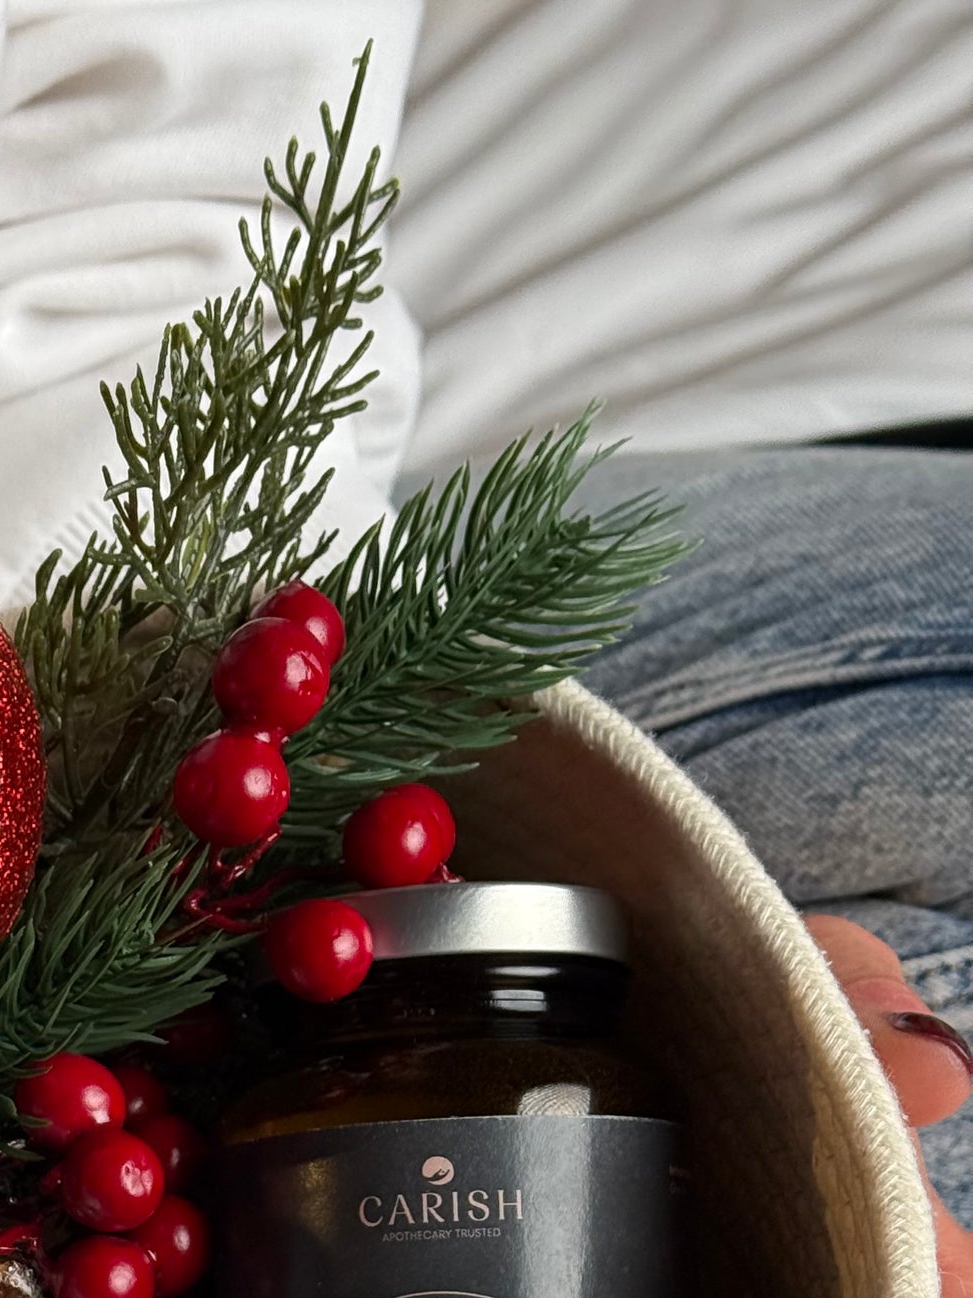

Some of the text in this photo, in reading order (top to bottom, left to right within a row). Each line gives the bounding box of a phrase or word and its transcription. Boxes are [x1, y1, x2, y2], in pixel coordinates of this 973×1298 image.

[358, 1189, 524, 1227] CARISH
[382, 1227, 501, 1242] APOTHECARY TRUSTED
